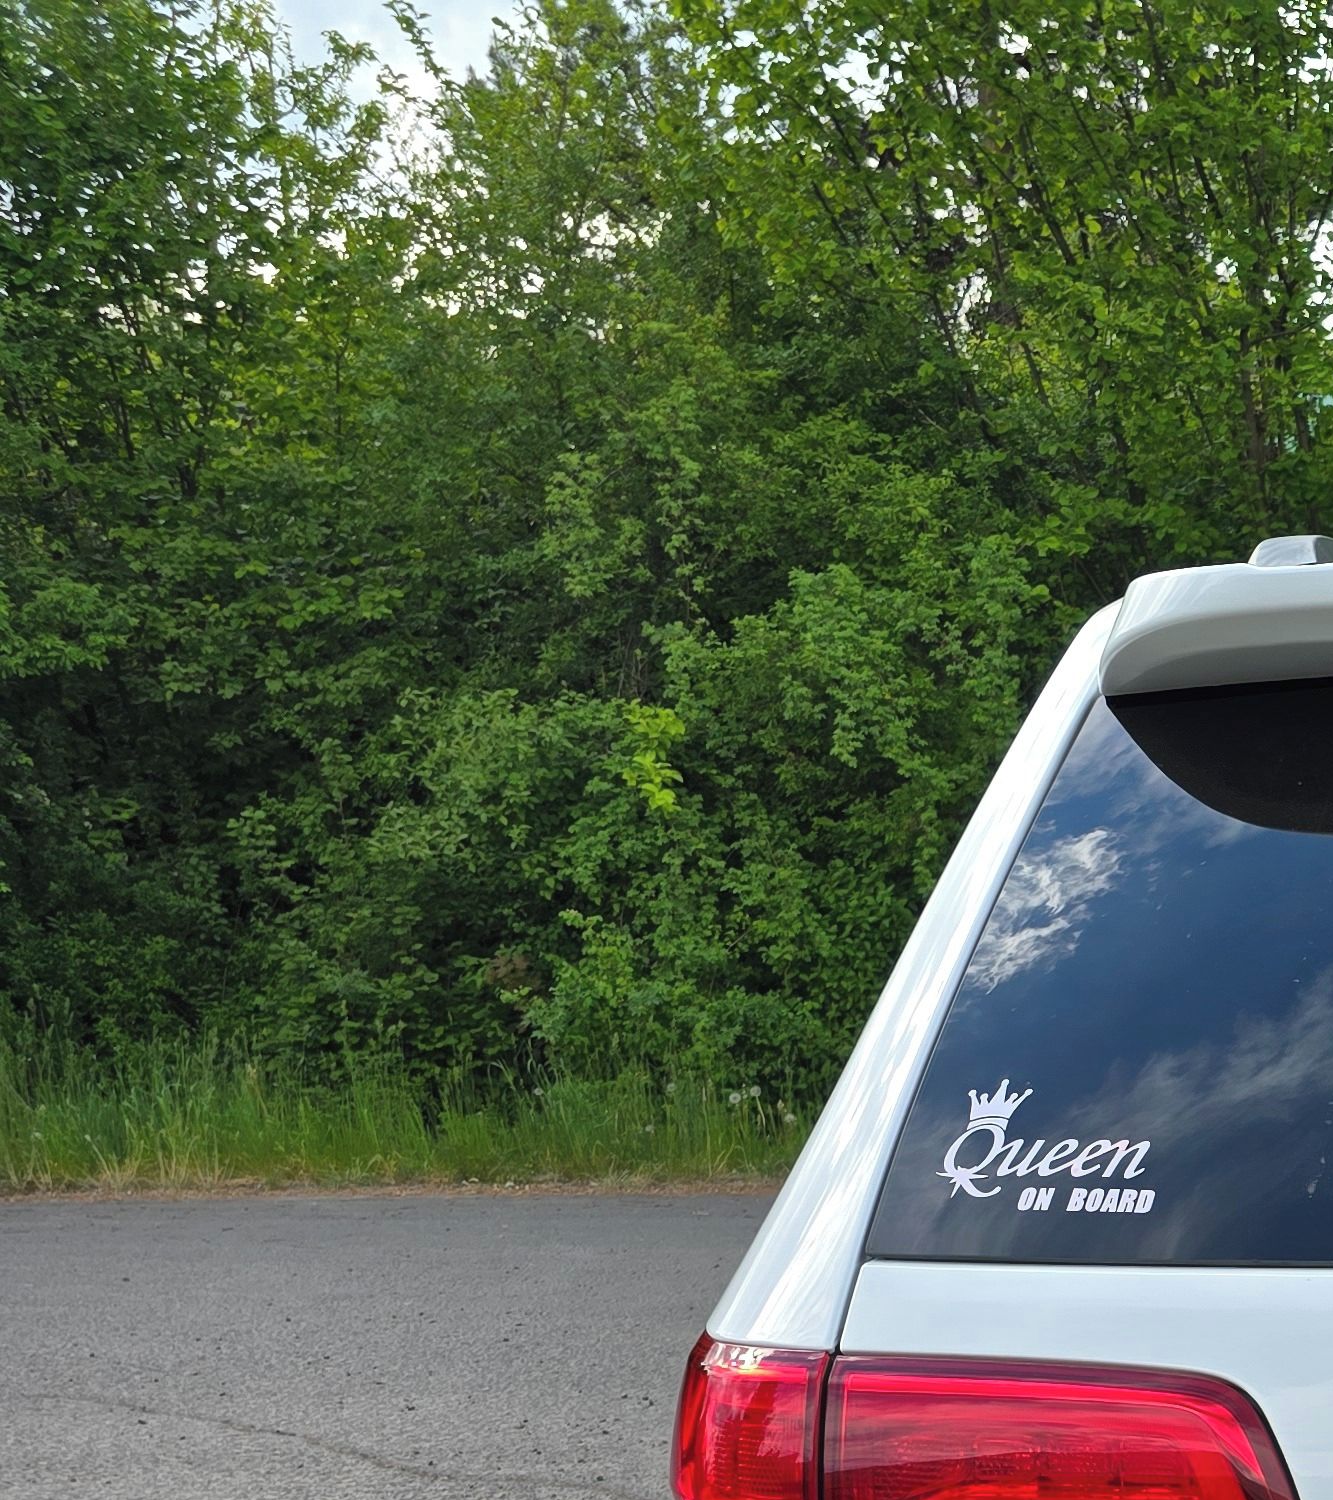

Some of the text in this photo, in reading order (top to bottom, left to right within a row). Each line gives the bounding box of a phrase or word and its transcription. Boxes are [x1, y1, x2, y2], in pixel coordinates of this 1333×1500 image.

[936, 1123, 1151, 1199] Queen
[1017, 1187, 1156, 1214] ON BOARD
